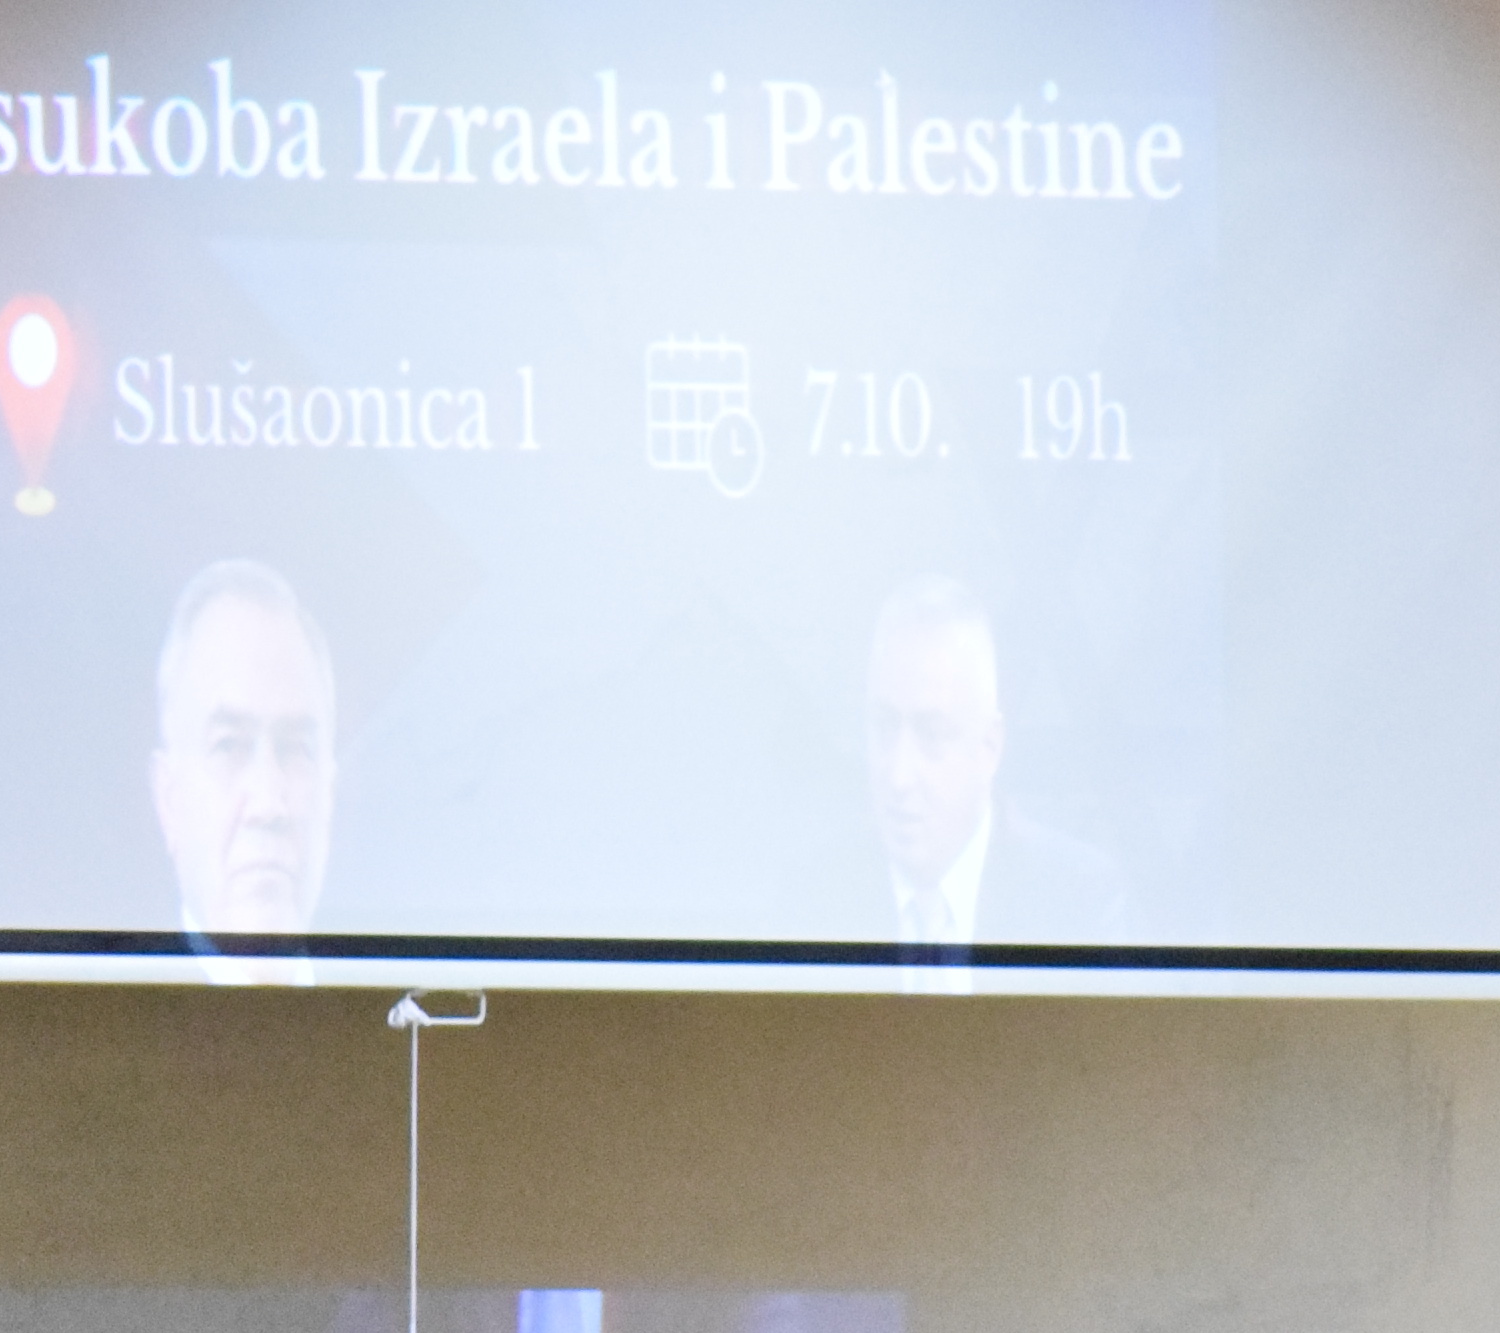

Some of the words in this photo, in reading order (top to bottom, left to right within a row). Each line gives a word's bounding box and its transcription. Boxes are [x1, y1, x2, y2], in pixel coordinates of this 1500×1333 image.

[354, 69, 679, 189] Izraela
[707, 72, 736, 189] i
[762, 66, 1184, 200] Palestine
[111, 350, 491, 451] Slušaonica
[802, 368, 951, 460] 7.10.
[1014, 372, 1134, 463] 19h
